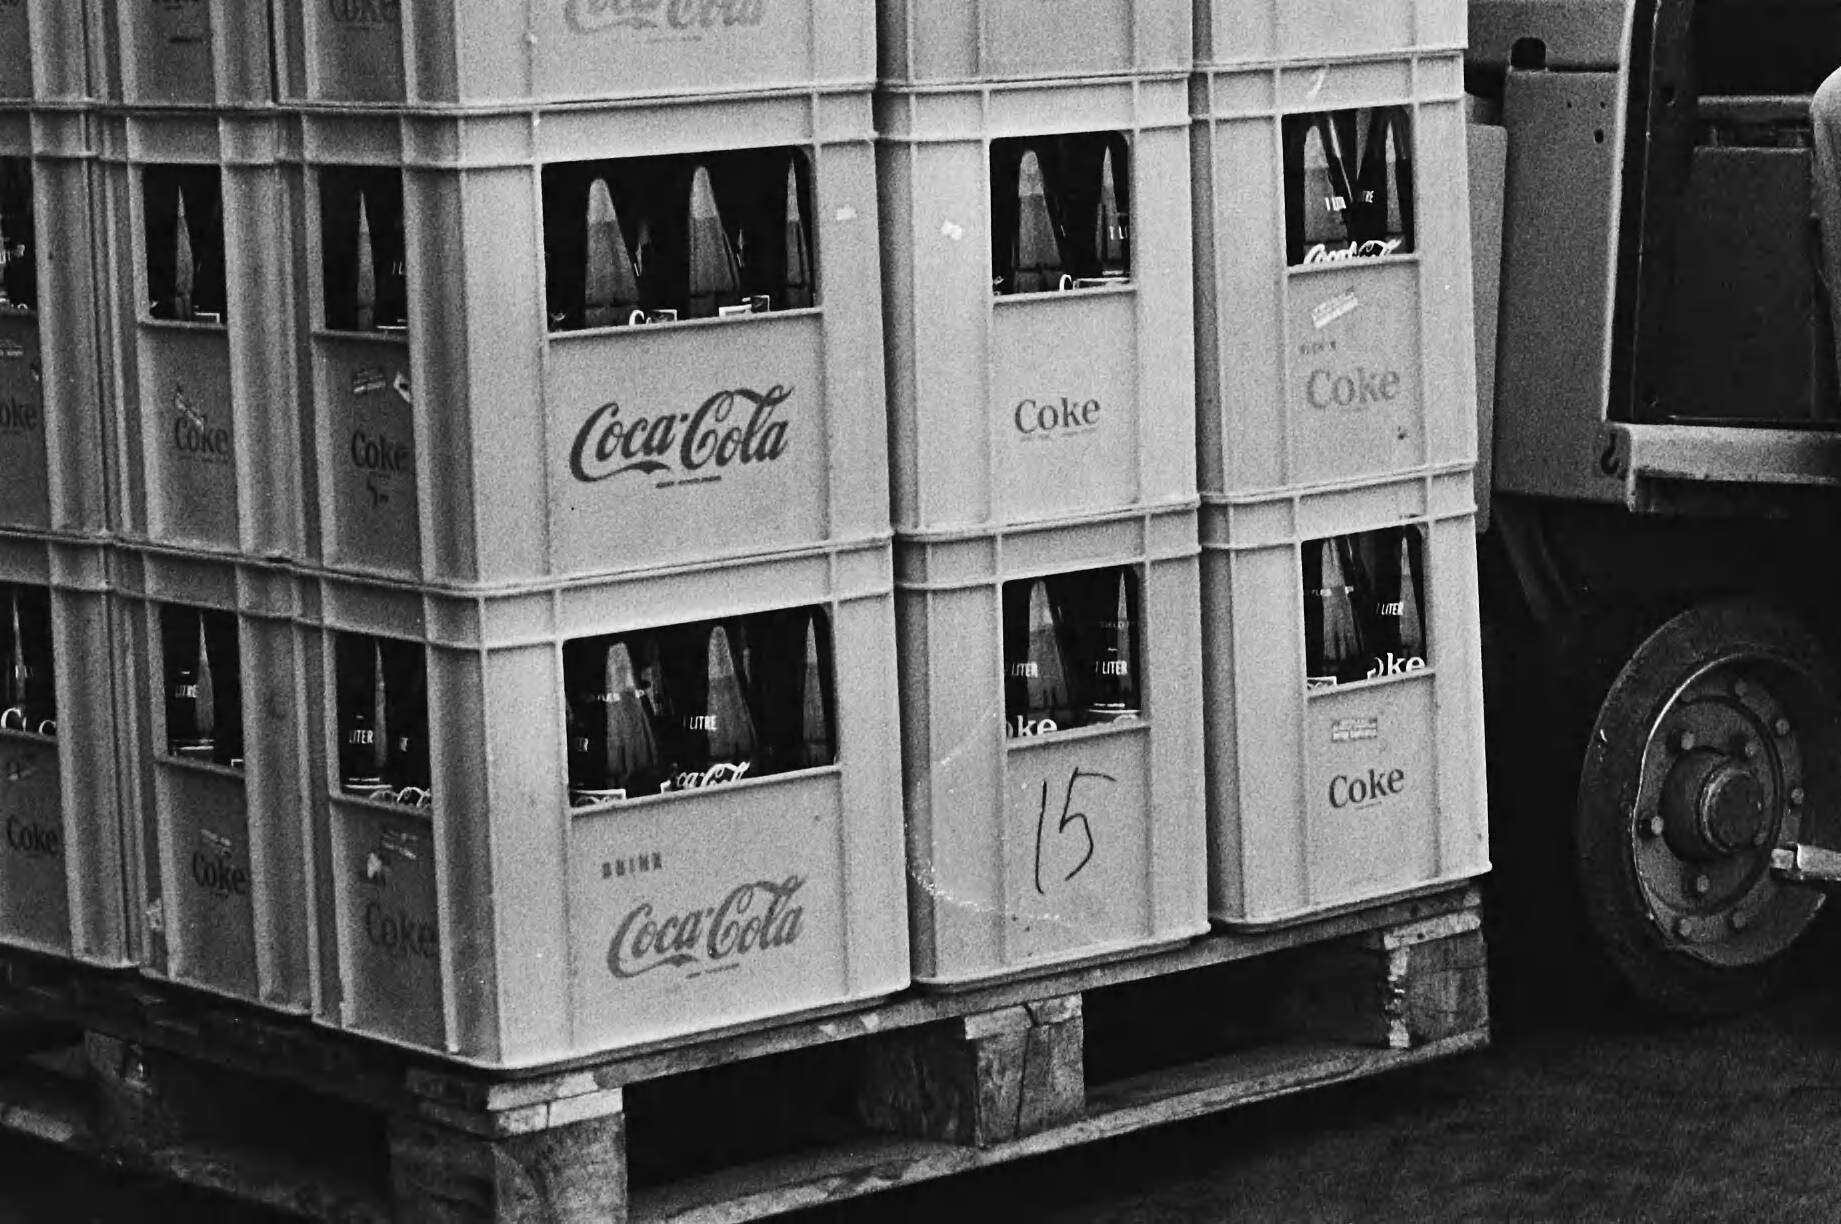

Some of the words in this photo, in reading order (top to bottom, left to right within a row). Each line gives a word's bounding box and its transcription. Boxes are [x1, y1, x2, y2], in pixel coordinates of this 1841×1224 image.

[1306, 366, 1400, 410] Coke
[175, 413, 230, 455] Coke
[1014, 396, 1101, 435] Coke
[1380, 601, 1404, 616] LITER
[1102, 659, 1129, 676] LITER
[689, 715, 718, 731] LITRE
[1328, 767, 1405, 809] Coke
[6, 814, 60, 855] Coke
[1035, 766, 1117, 894] 15
[192, 849, 247, 895] Coke
